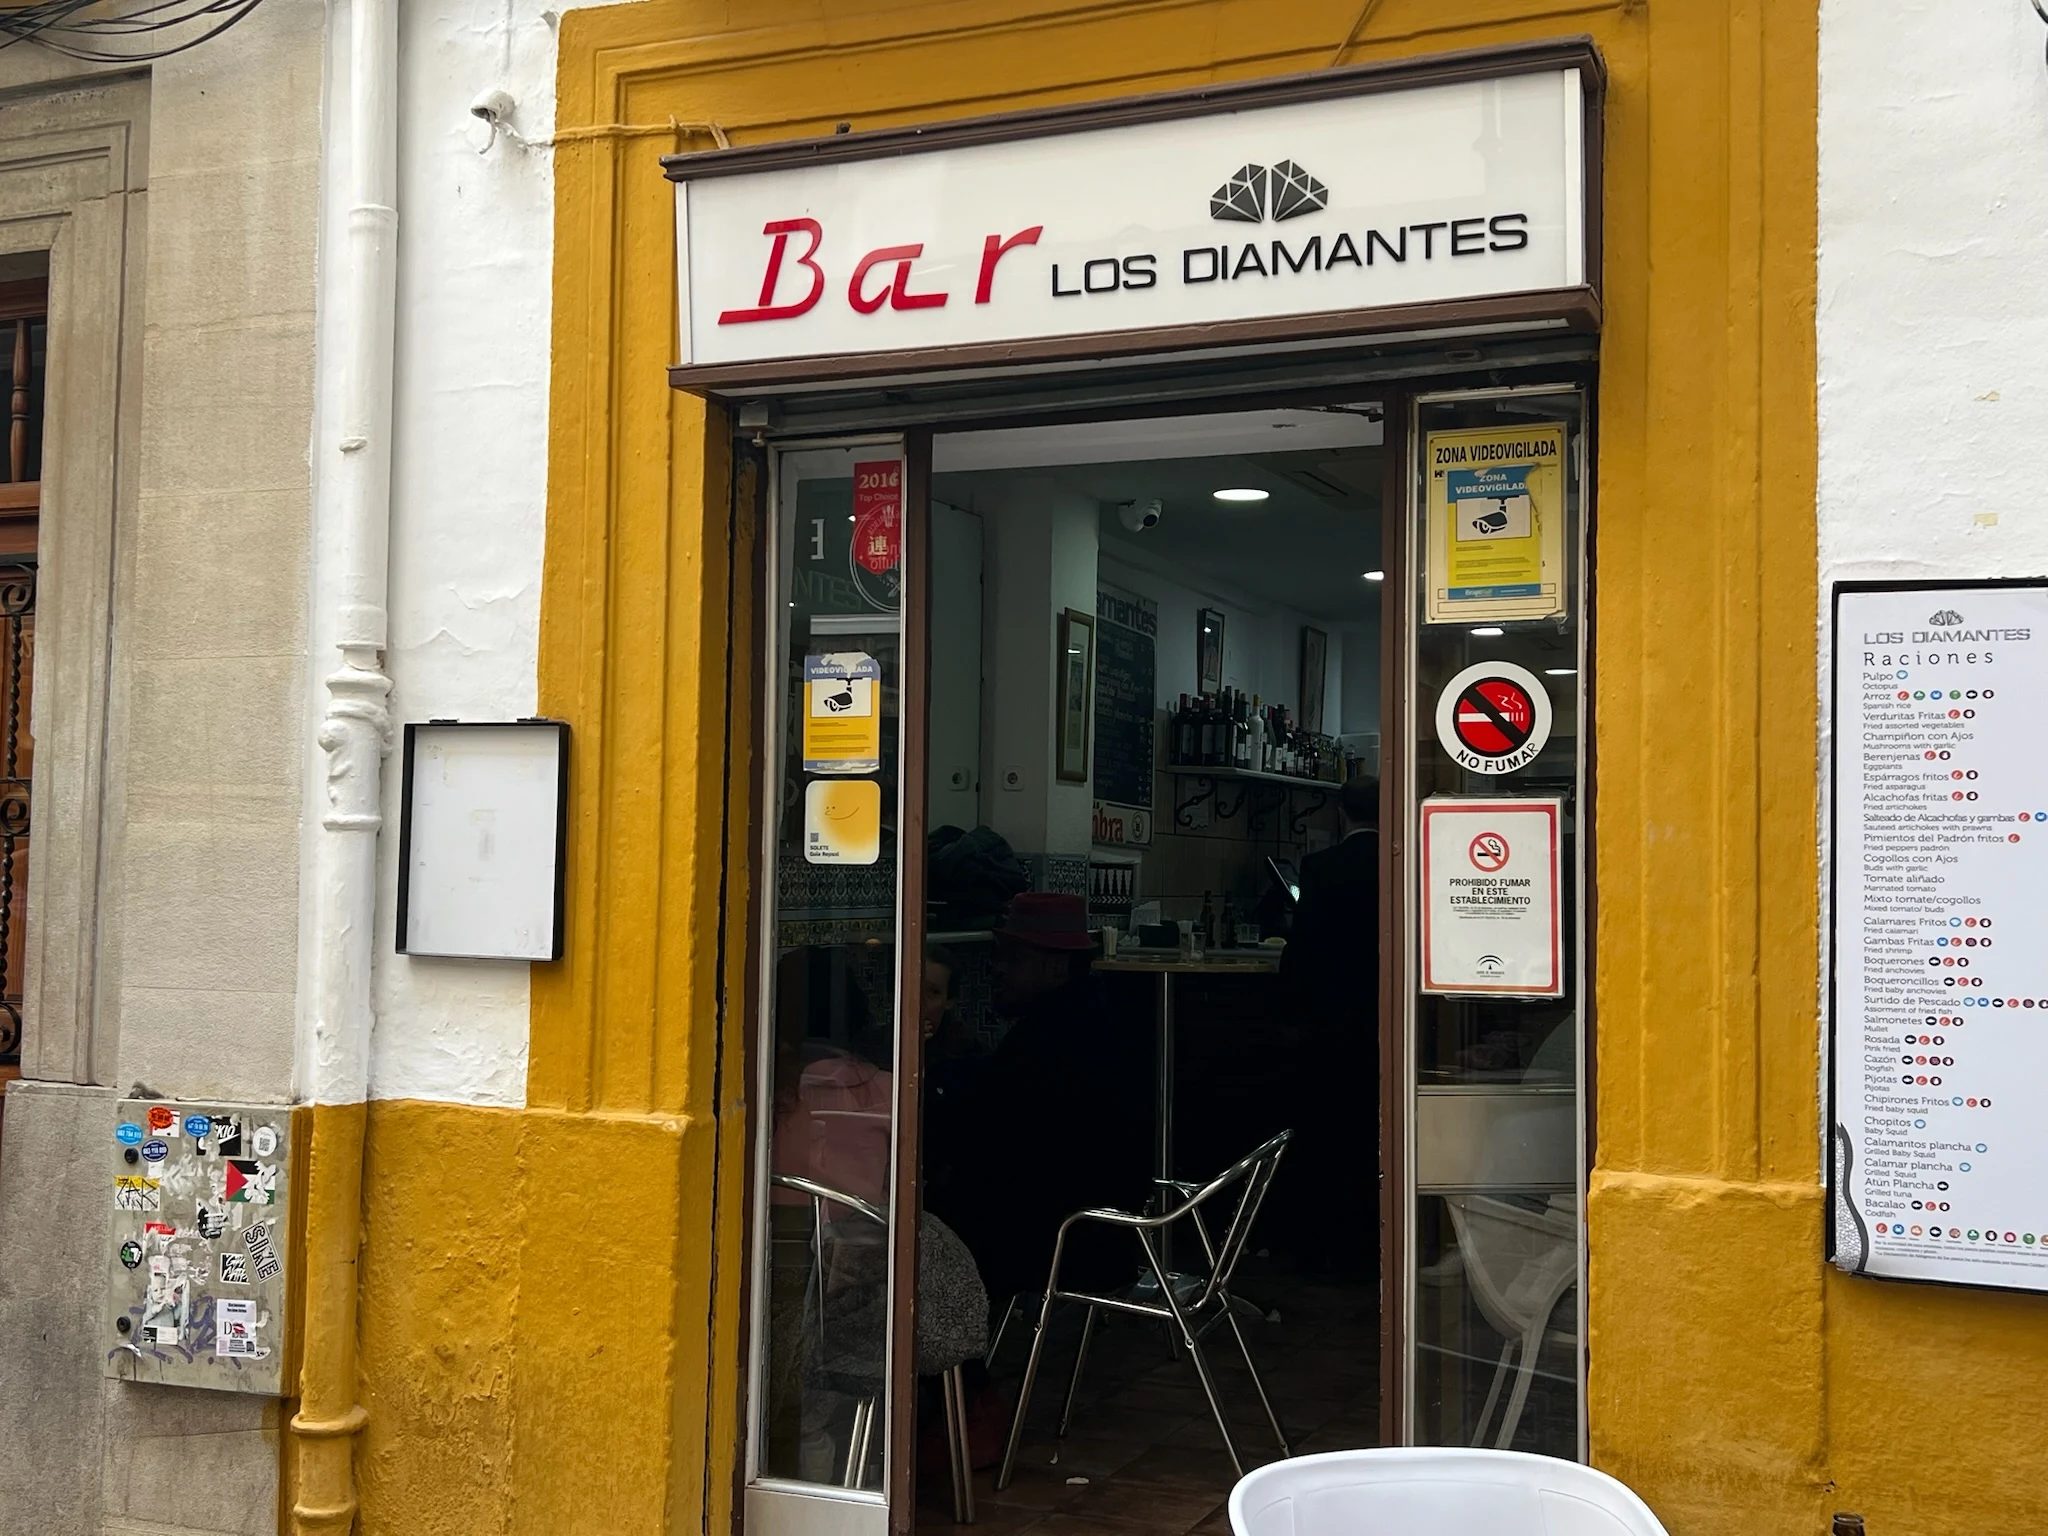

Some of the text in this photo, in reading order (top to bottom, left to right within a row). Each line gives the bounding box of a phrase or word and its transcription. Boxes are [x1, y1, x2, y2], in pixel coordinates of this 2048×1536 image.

[718, 212, 1530, 326] Bar LOS DIAMANTES
[1436, 440, 1557, 464] ZONA VIDEOVIGILADA
[859, 472, 899, 489] 2016
[1479, 473, 1507, 482] ZONA
[1455, 482, 1527, 494] VIDEOVIGILAD
[1097, 591, 1158, 636] mantes
[1864, 629, 2031, 644] LOS DIAMANTES
[1864, 651, 1993, 666] Raciones
[1863, 672, 1894, 682] Pulpo
[1863, 692, 1891, 701] Arroz
[1863, 712, 1945, 721] Verduritas Fritas
[1921, 722, 1964, 730] vegetables
[1863, 732, 1925, 741] Champiñon
[1951, 732, 1974, 741] Ajos
[1456, 742, 1540, 772] NO FUMAR
[1864, 753, 1920, 762] Berenjenas
[1864, 773, 1949, 782] Espárragos fritos
[1864, 814, 1902, 822] Salteado
[1917, 814, 1968, 822] Alcachofas
[1970, 815, 1974, 823] y
[1977, 814, 2015, 823] gambas
[1864, 834, 2004, 843] Pimientos del Padrón fritos
[1864, 854, 1909, 864] Cogollos
[1935, 855, 1958, 863] Ajos
[1449, 878, 1531, 887] PROHIBIDO FUMAR
[1864, 874, 1945, 883] Tomate aliñado
[1472, 887, 1509, 896] EN ESTE
[1450, 896, 1531, 905] ESTABLECIMIENTO
[1864, 895, 1981, 906] Mixto tomate/cogollos
[1864, 917, 1947, 927] Calamares Fritos
[1864, 937, 1934, 946] Gambas Fritas
[1864, 956, 1924, 966] Boquerones
[1864, 976, 1939, 986] Boqueroncillos
[1864, 995, 1960, 1006] Surtido de Pescado
[1864, 1015, 1922, 1025] Salmonetes
[1864, 1035, 1900, 1044] Rosada
[1864, 1055, 1896, 1063] Cazón
[1864, 1075, 1897, 1084] Pijotas
[1864, 1084, 1890, 1092] Pijotas
[1864, 1094, 1949, 1106] Chipirones Fritos
[1886, 1106, 1904, 1114] baby
[1907, 1107, 1928, 1115] squid
[1864, 1116, 1911, 1127] Chopitos
[1865, 1127, 1908, 1136] Baby Squid
[1864, 1137, 1972, 1151] Calamaritos plancha
[1864, 1148, 1935, 1158] Grilled Baby Squid
[1864, 1158, 1953, 1171] Calamar plancha
[1865, 1169, 1917, 1179] Grilled Squid
[1893, 1180, 1934, 1191] Plancha
[1865, 1188, 1912, 1198] Grilled tuna
[1865, 1199, 1906, 1209] Bacalao
[1865, 1209, 1896, 1218] Codfish
